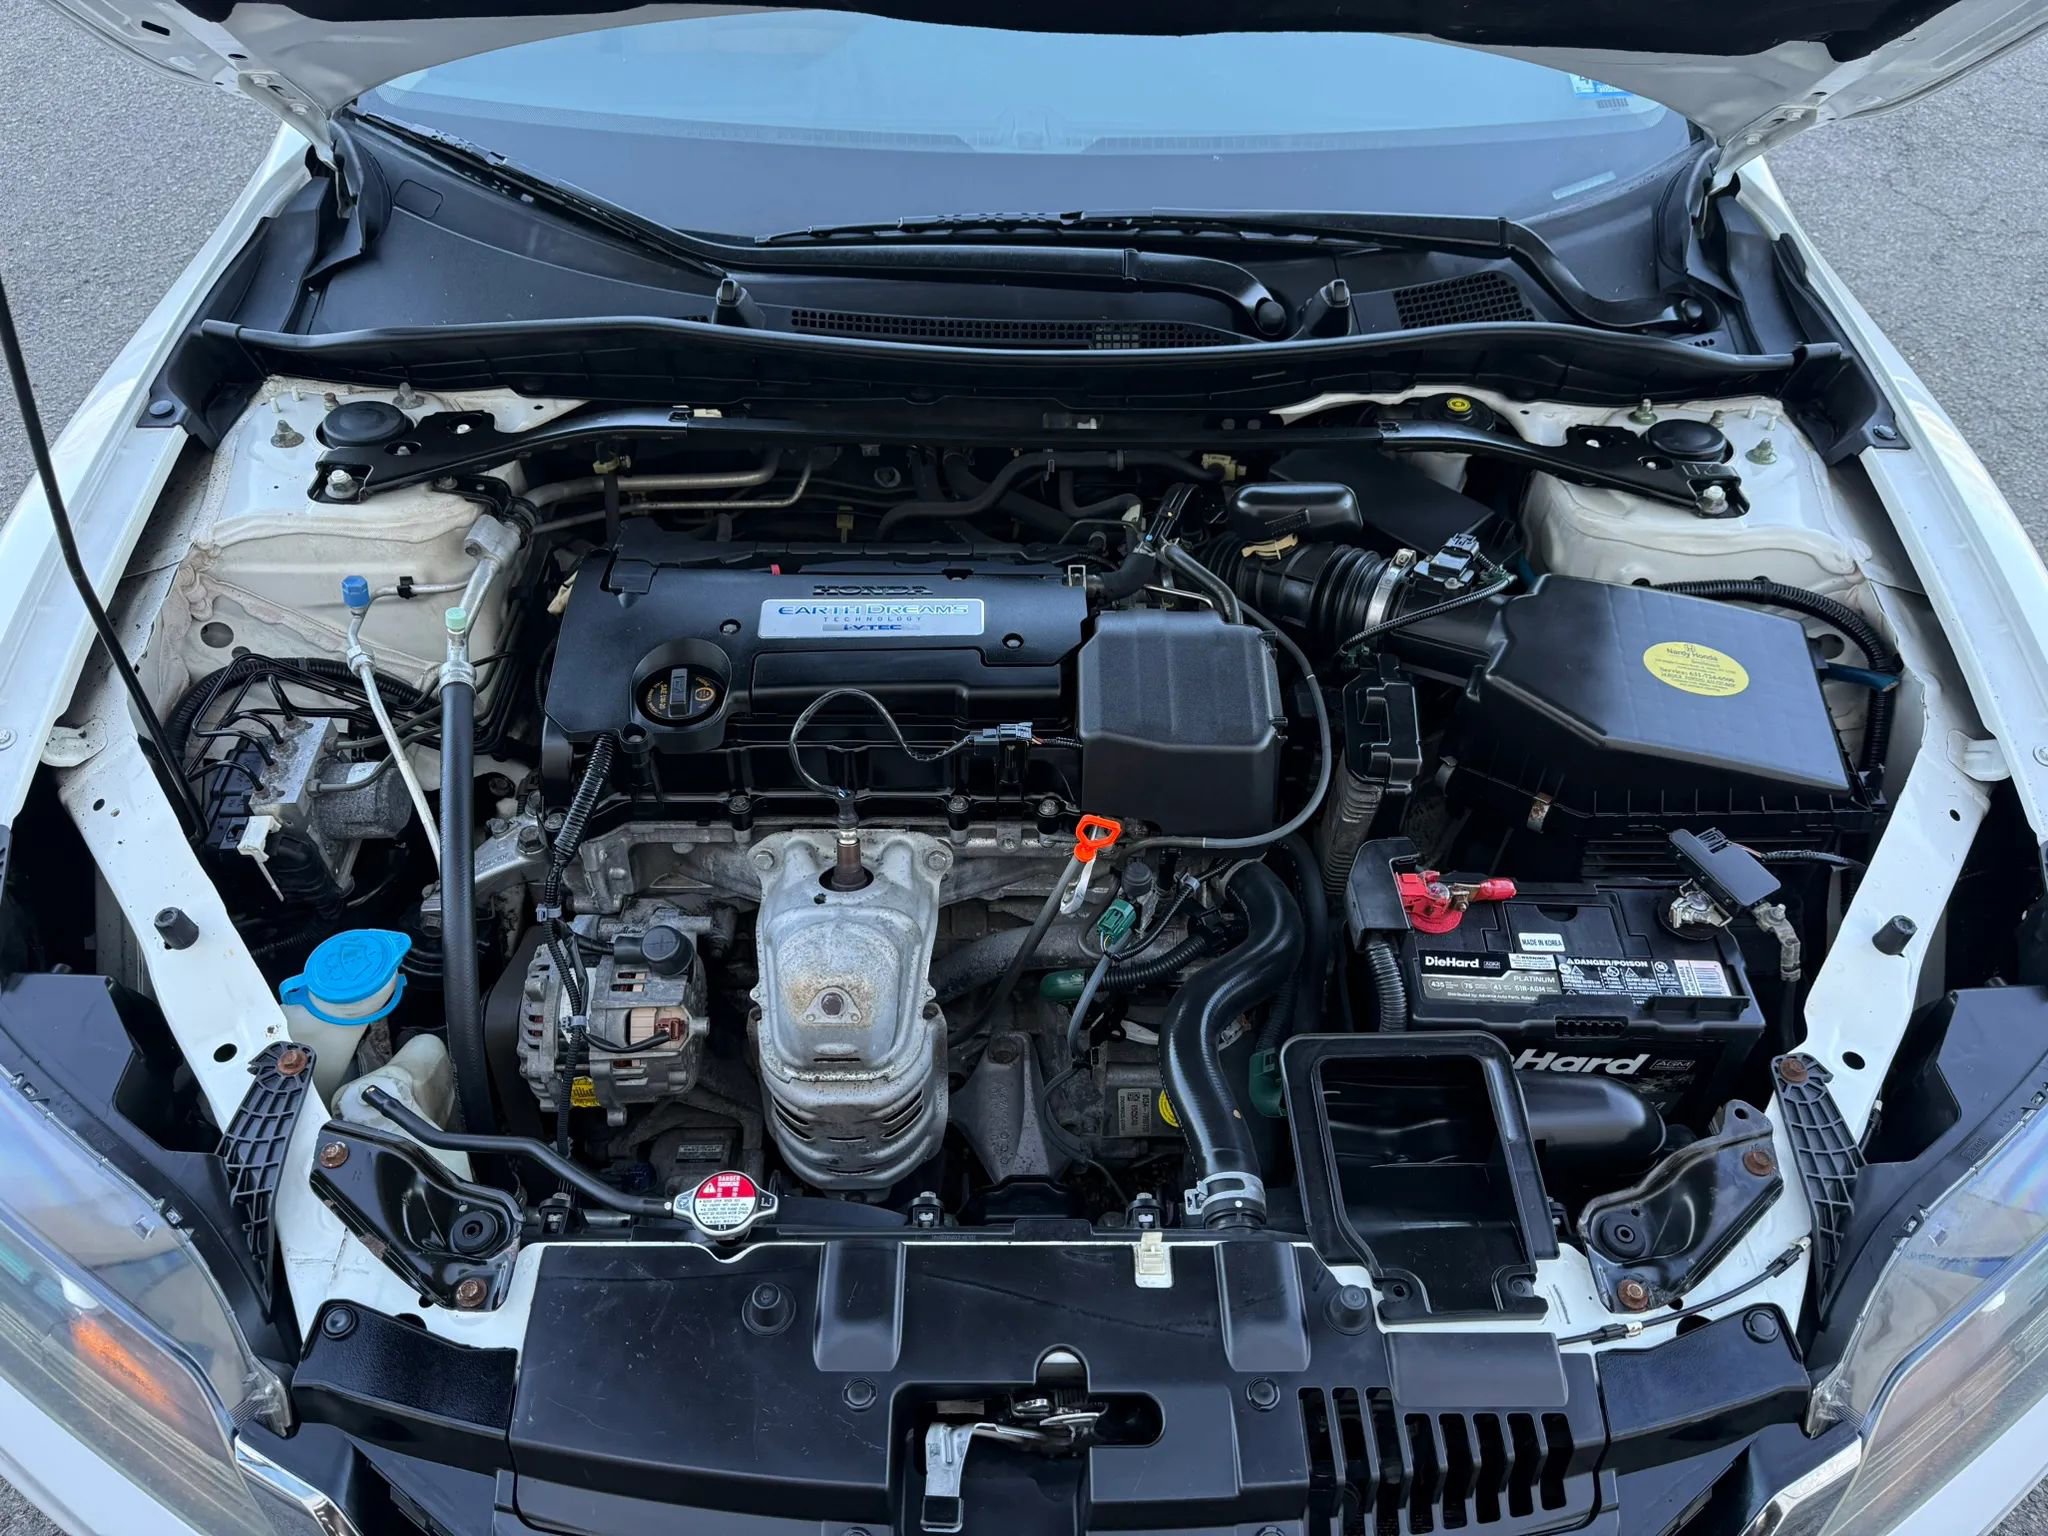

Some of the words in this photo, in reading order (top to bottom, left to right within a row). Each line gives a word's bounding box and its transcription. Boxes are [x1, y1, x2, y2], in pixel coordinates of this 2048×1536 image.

[813, 585, 933, 596] HONDA
[778, 604, 860, 615] EARTH
[867, 603, 969, 615] DREAMS
[1425, 956, 1480, 968] DieHard
[1574, 958, 1648, 968] DANGER/POISON
[1514, 975, 1555, 983] PLATINUM
